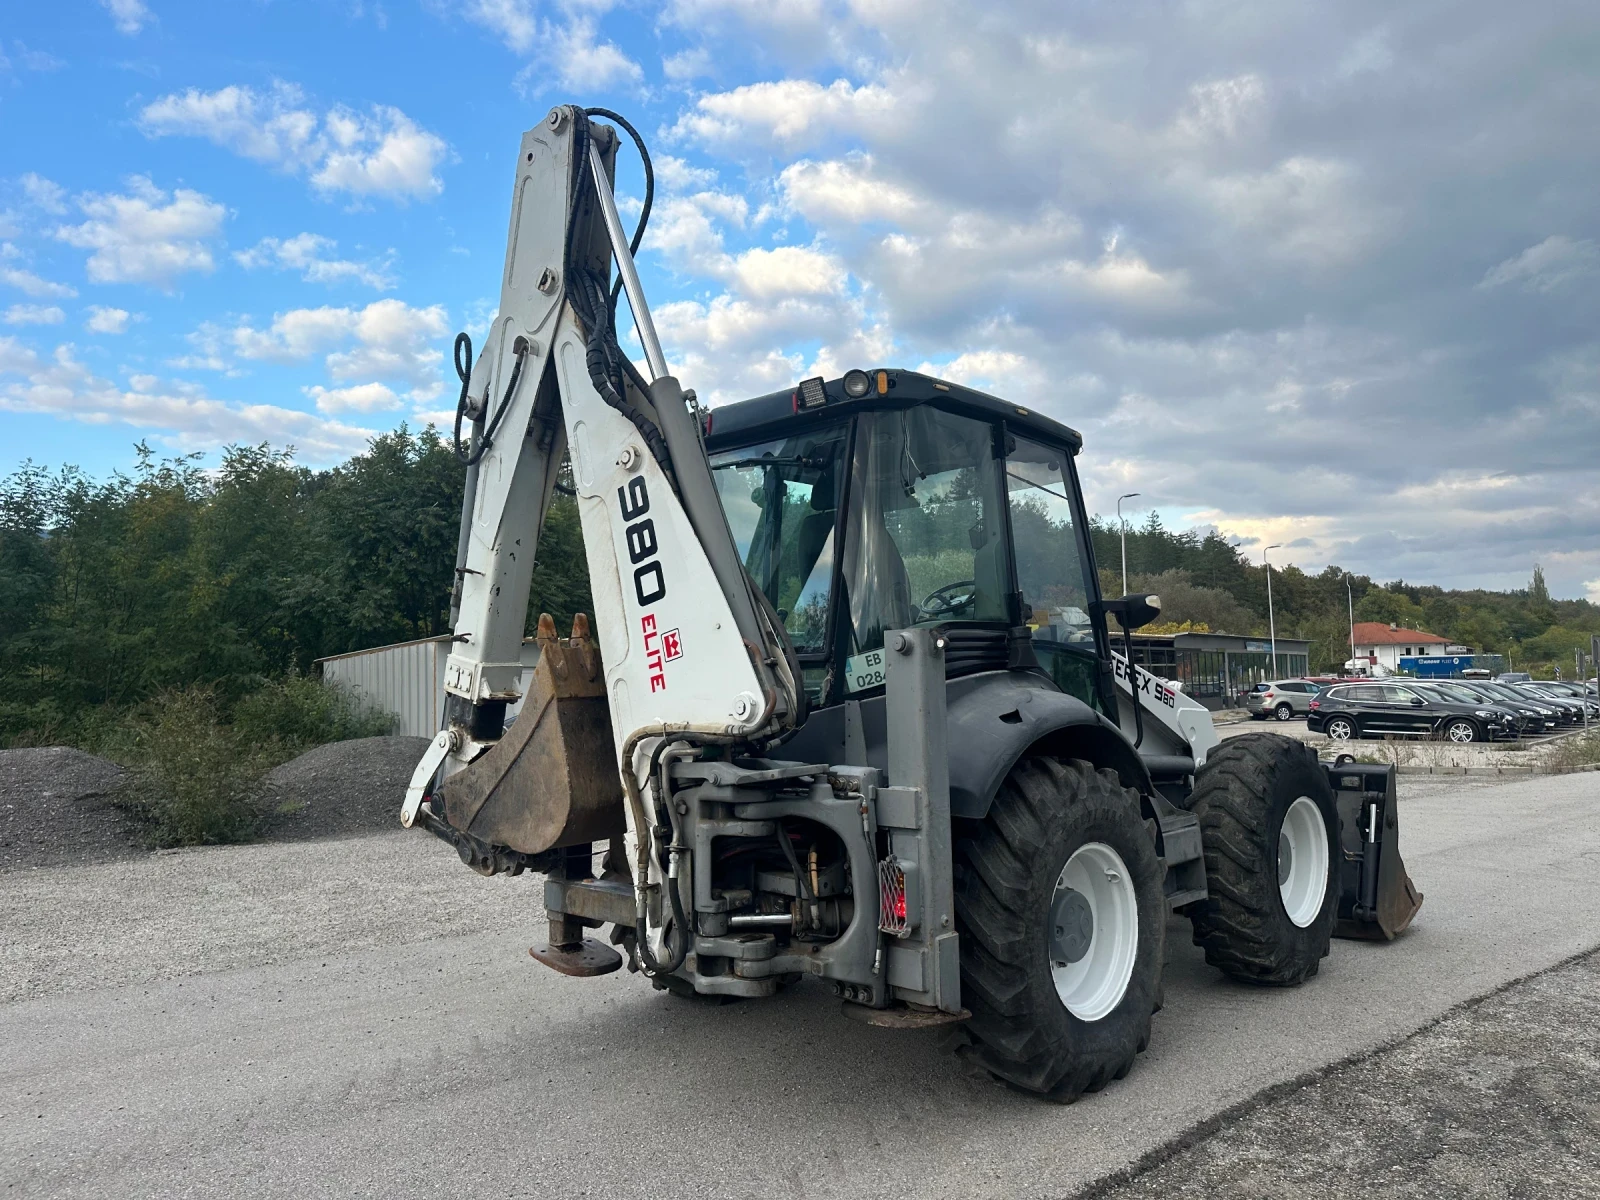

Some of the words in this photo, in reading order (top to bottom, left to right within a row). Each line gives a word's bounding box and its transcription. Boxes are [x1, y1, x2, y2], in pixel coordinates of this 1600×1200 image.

[617, 475, 666, 607] 980
[641, 613, 666, 693] ELITE
[865, 653, 882, 668] EB
[1154, 682, 1174, 708] 980
